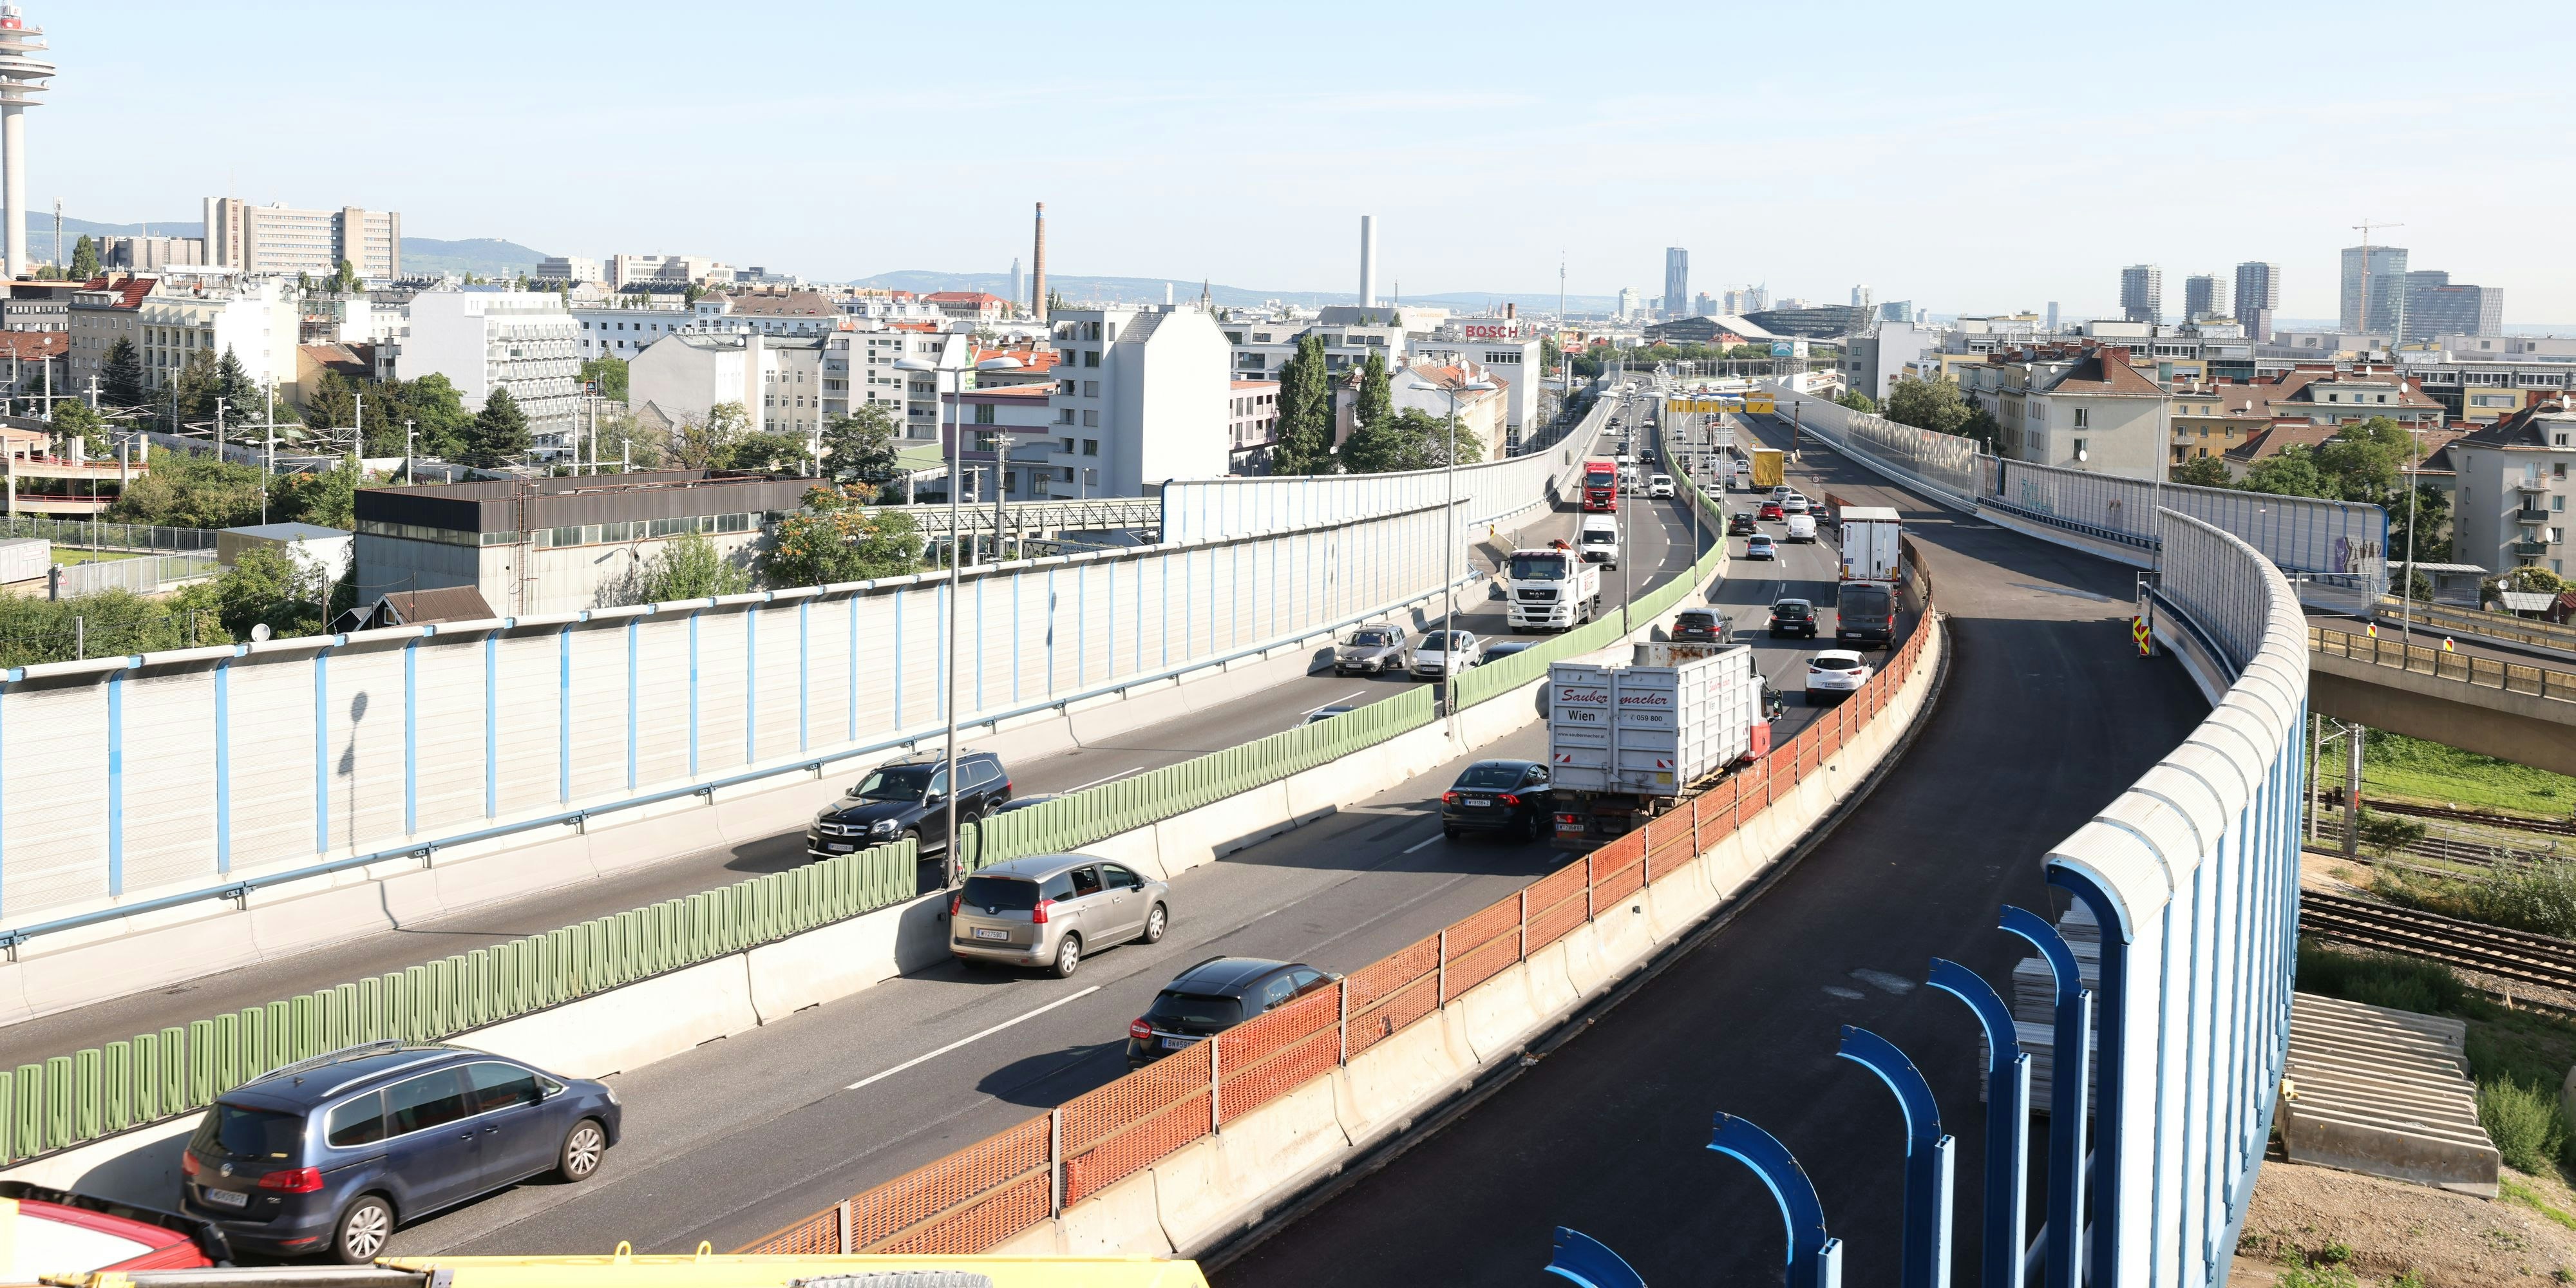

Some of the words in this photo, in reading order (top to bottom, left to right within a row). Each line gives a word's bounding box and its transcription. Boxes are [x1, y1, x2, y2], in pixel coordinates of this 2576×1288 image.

[1465, 325, 1519, 338] BOSCH
[1562, 689, 1608, 703] Sauber
[1619, 692, 1668, 705] macher
[1568, 710, 1595, 722] Wien
[1168, 1039, 1176, 1048] BN
